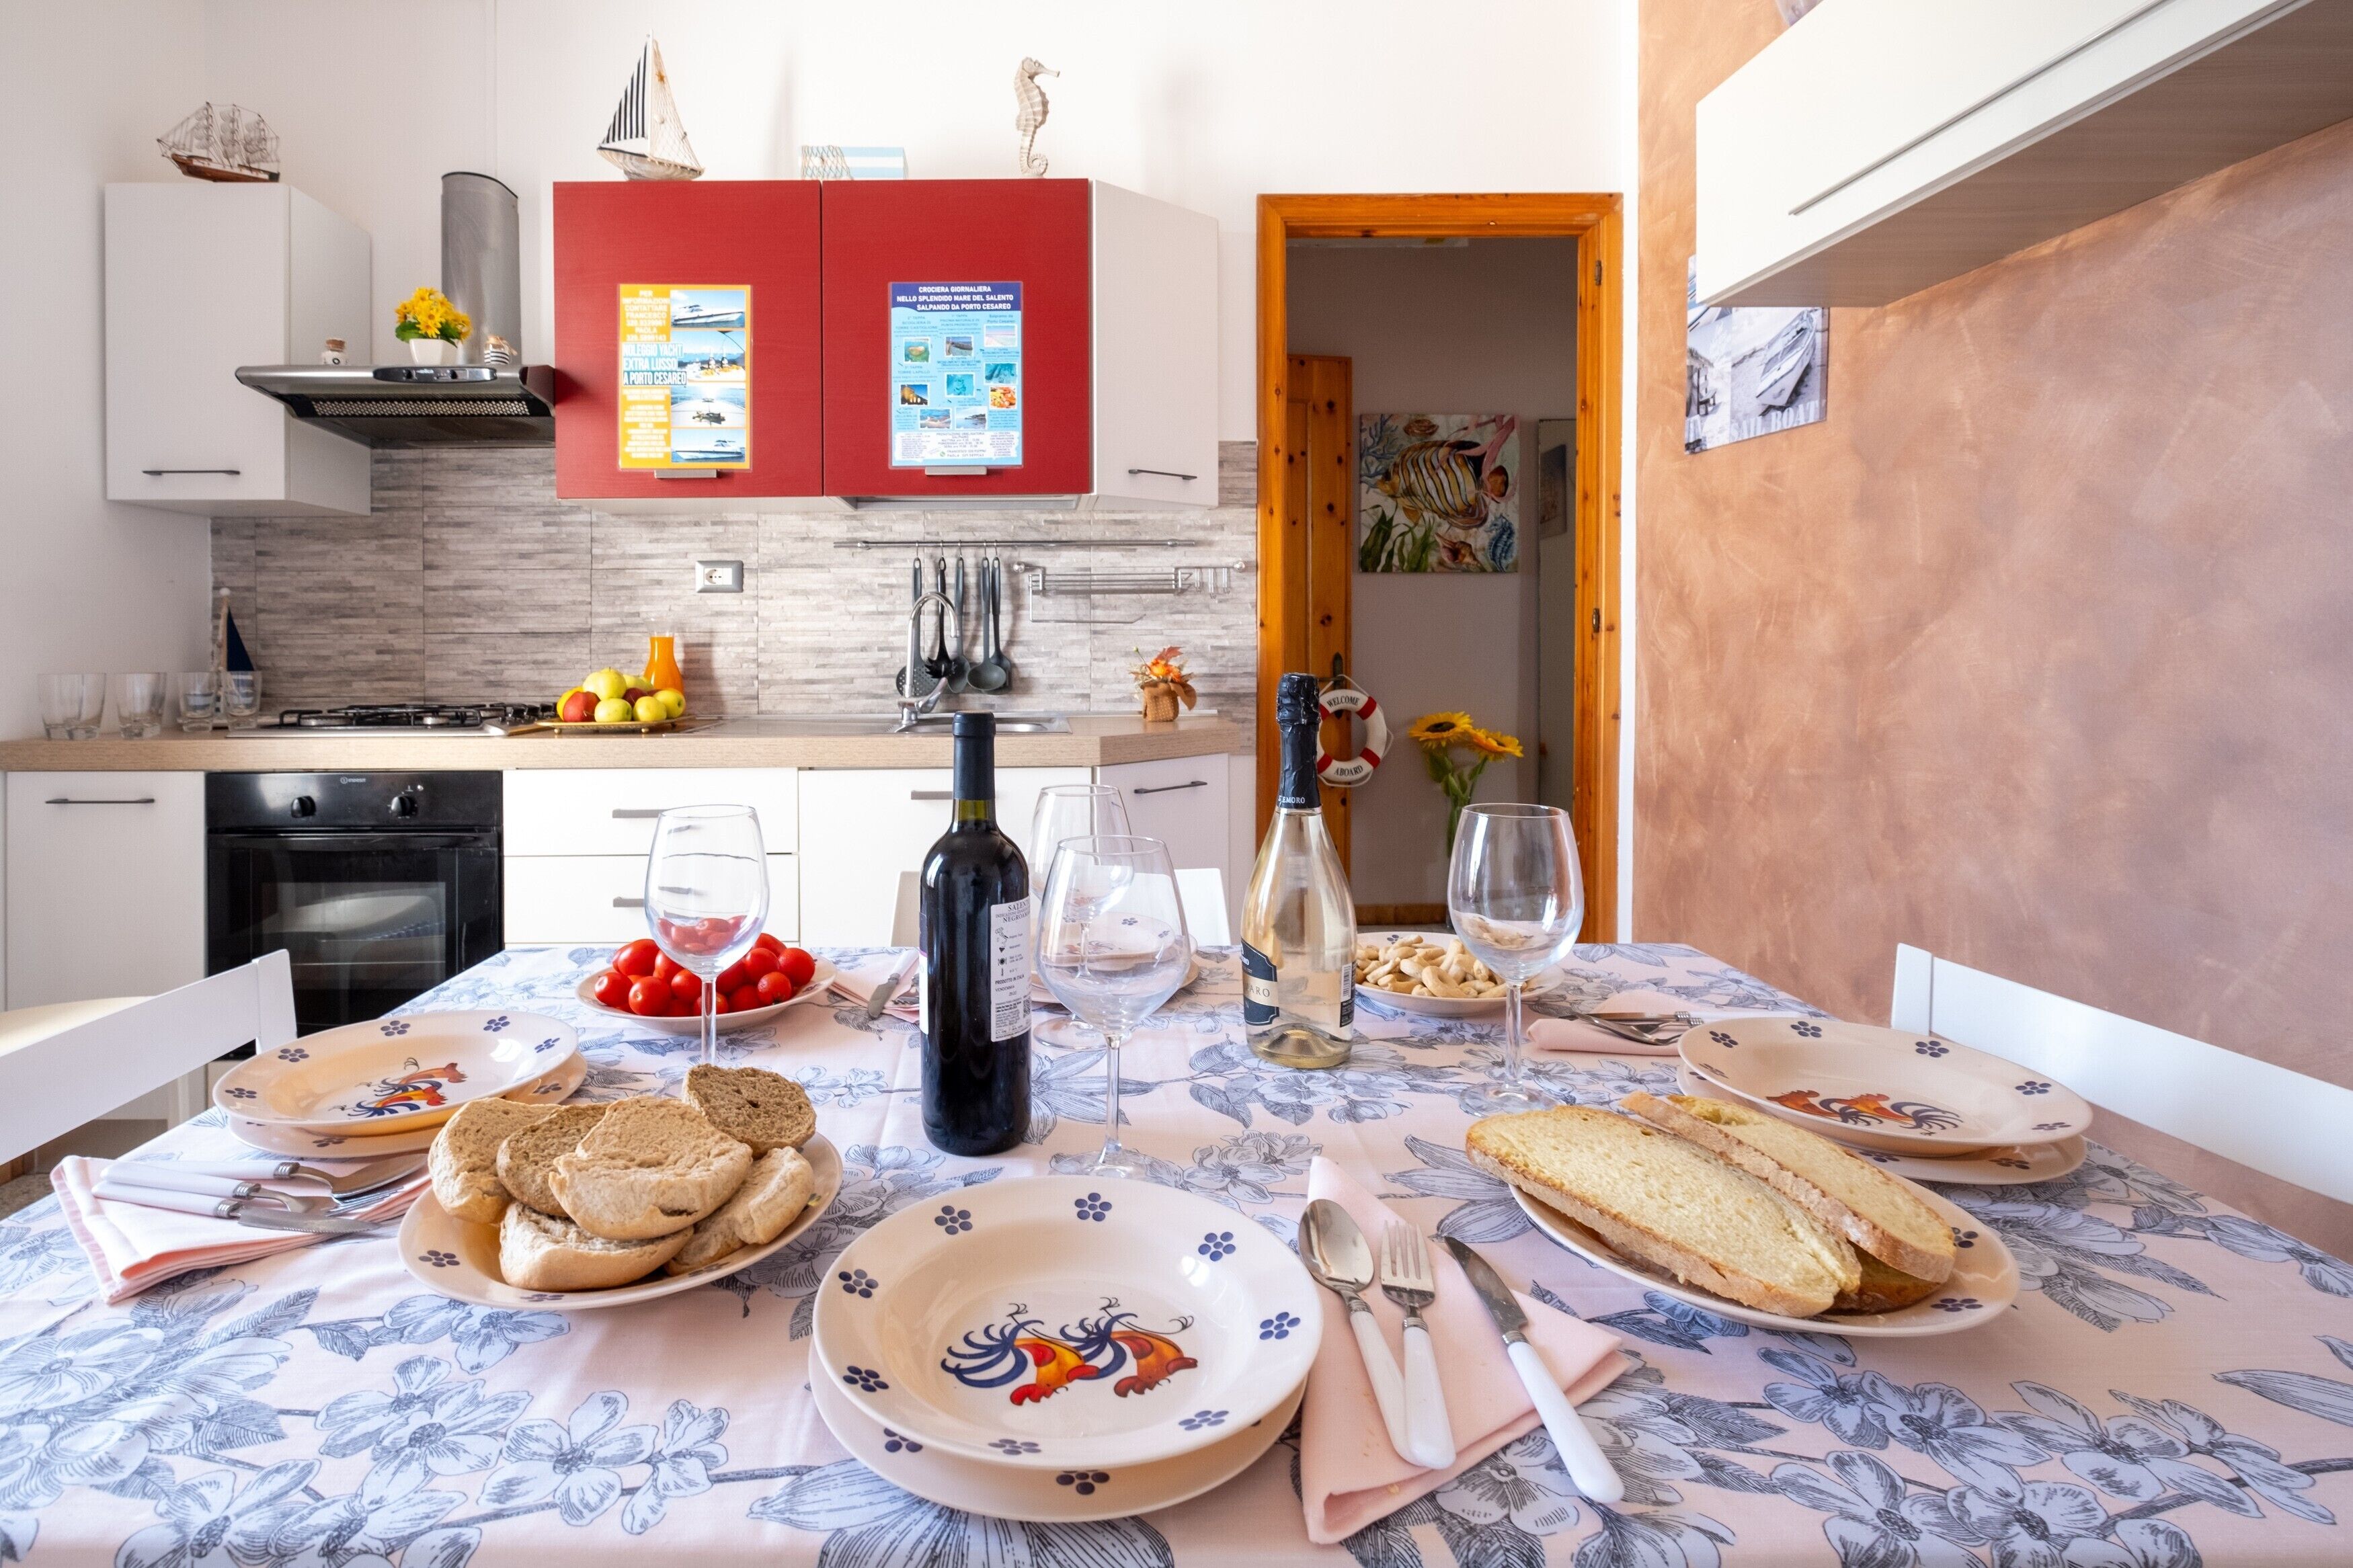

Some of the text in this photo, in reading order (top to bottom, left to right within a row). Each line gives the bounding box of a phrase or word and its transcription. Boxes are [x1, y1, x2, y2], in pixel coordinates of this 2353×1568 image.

[623, 343, 682, 357] NOLEGGIO YACHT
[623, 358, 676, 370] EXTRA LUSSO
[623, 372, 686, 384] A PORTO CESAREO
[1771, 400, 1819, 431] BOAT
[1326, 696, 1360, 708] WELCOME
[1334, 765, 1363, 776] ABOARD
[1248, 984, 1270, 997] ARO
